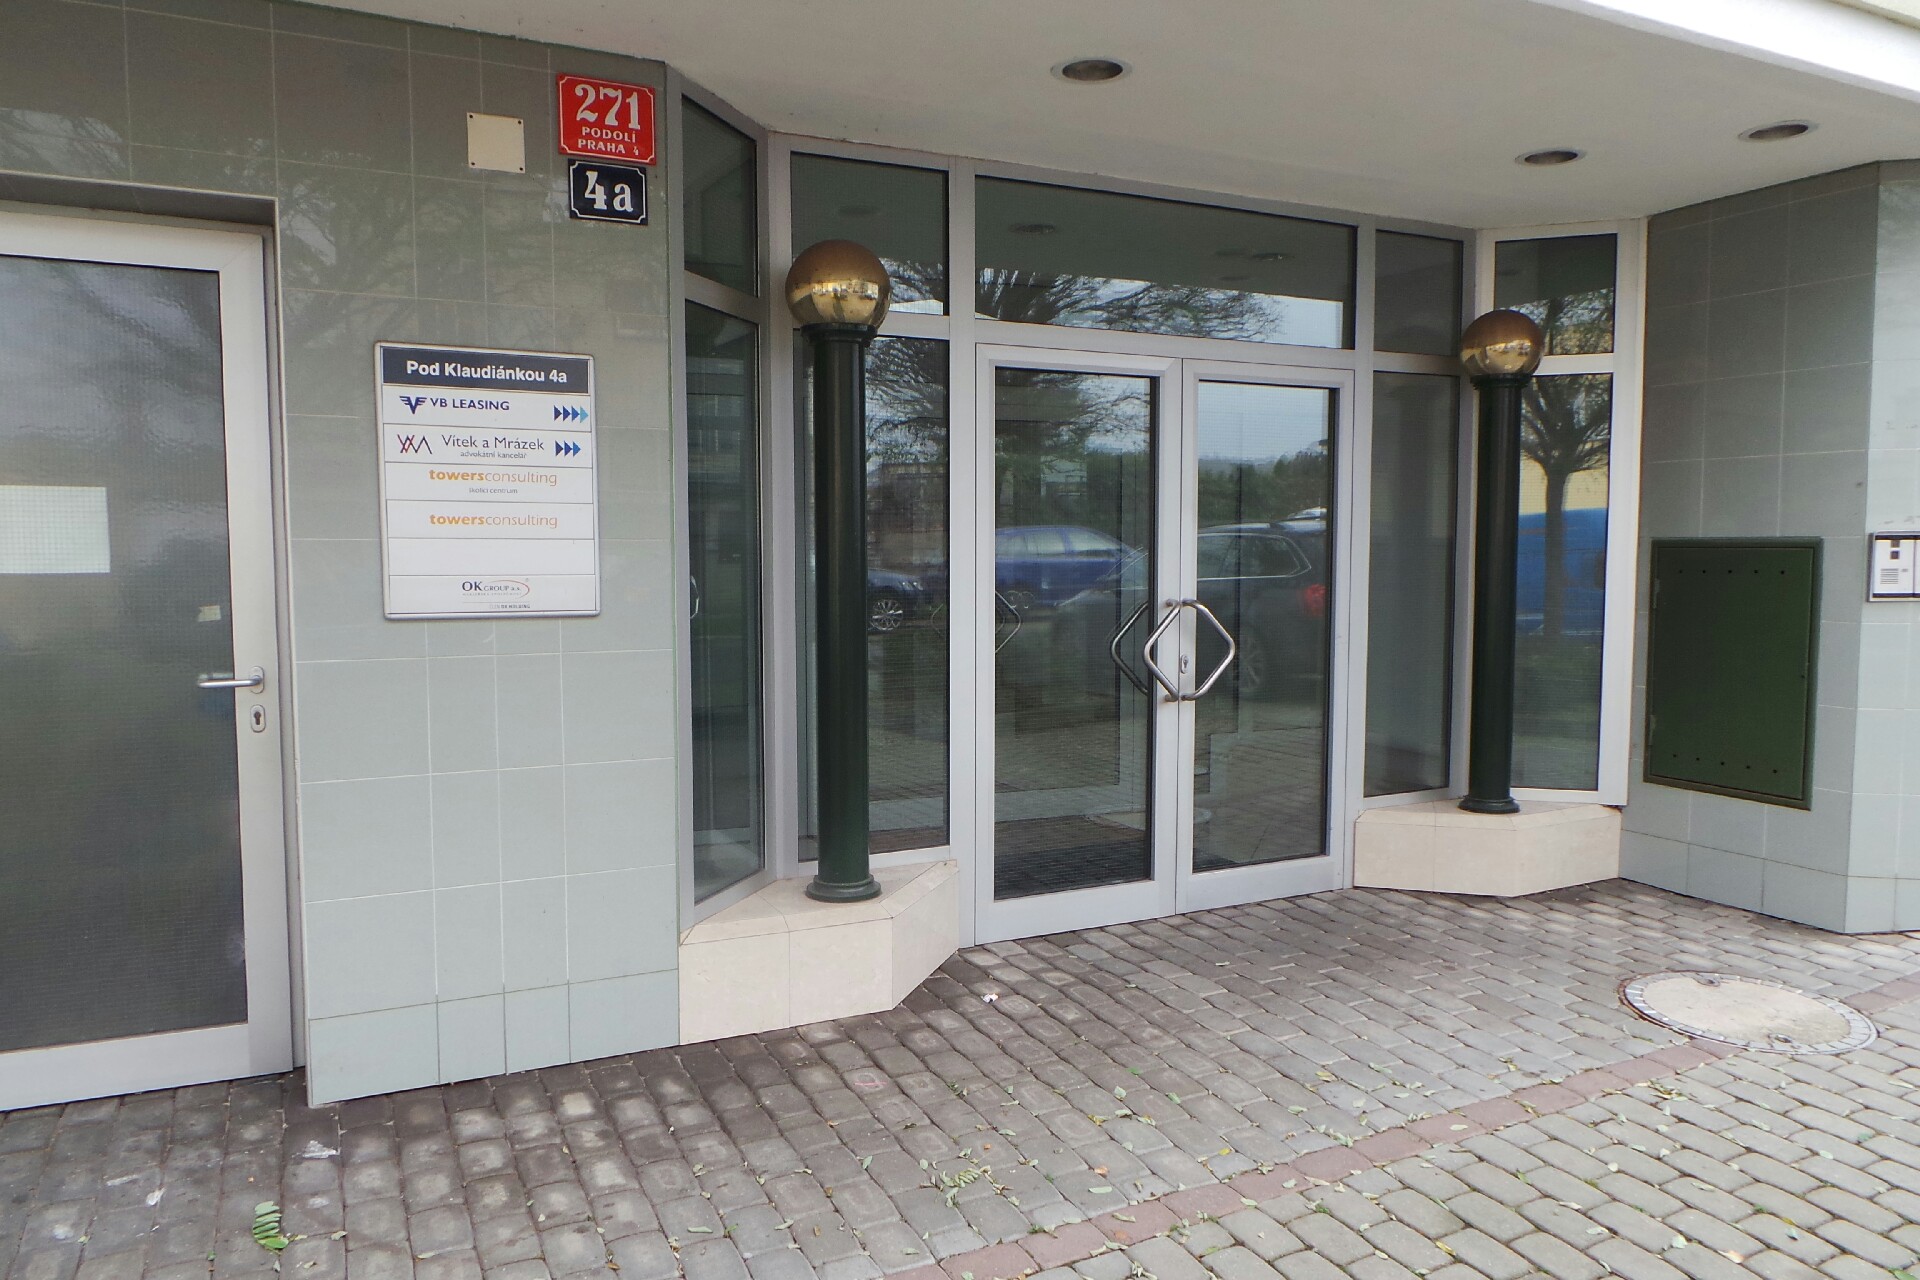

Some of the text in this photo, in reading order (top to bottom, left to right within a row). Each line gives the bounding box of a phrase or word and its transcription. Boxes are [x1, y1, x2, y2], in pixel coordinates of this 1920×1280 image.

[575, 84, 640, 130] 271
[582, 126, 636, 143] PODOLÍ
[577, 138, 639, 156] PRAHA 4
[584, 171, 634, 212] 4a
[406, 360, 568, 383] Pod Klaudiánkou 4a
[430, 398, 510, 411] VB LEASING
[441, 434, 545, 450] Vítek a Mrázek
[429, 469, 557, 486] towersconsulting
[429, 514, 558, 529] towersconsulting
